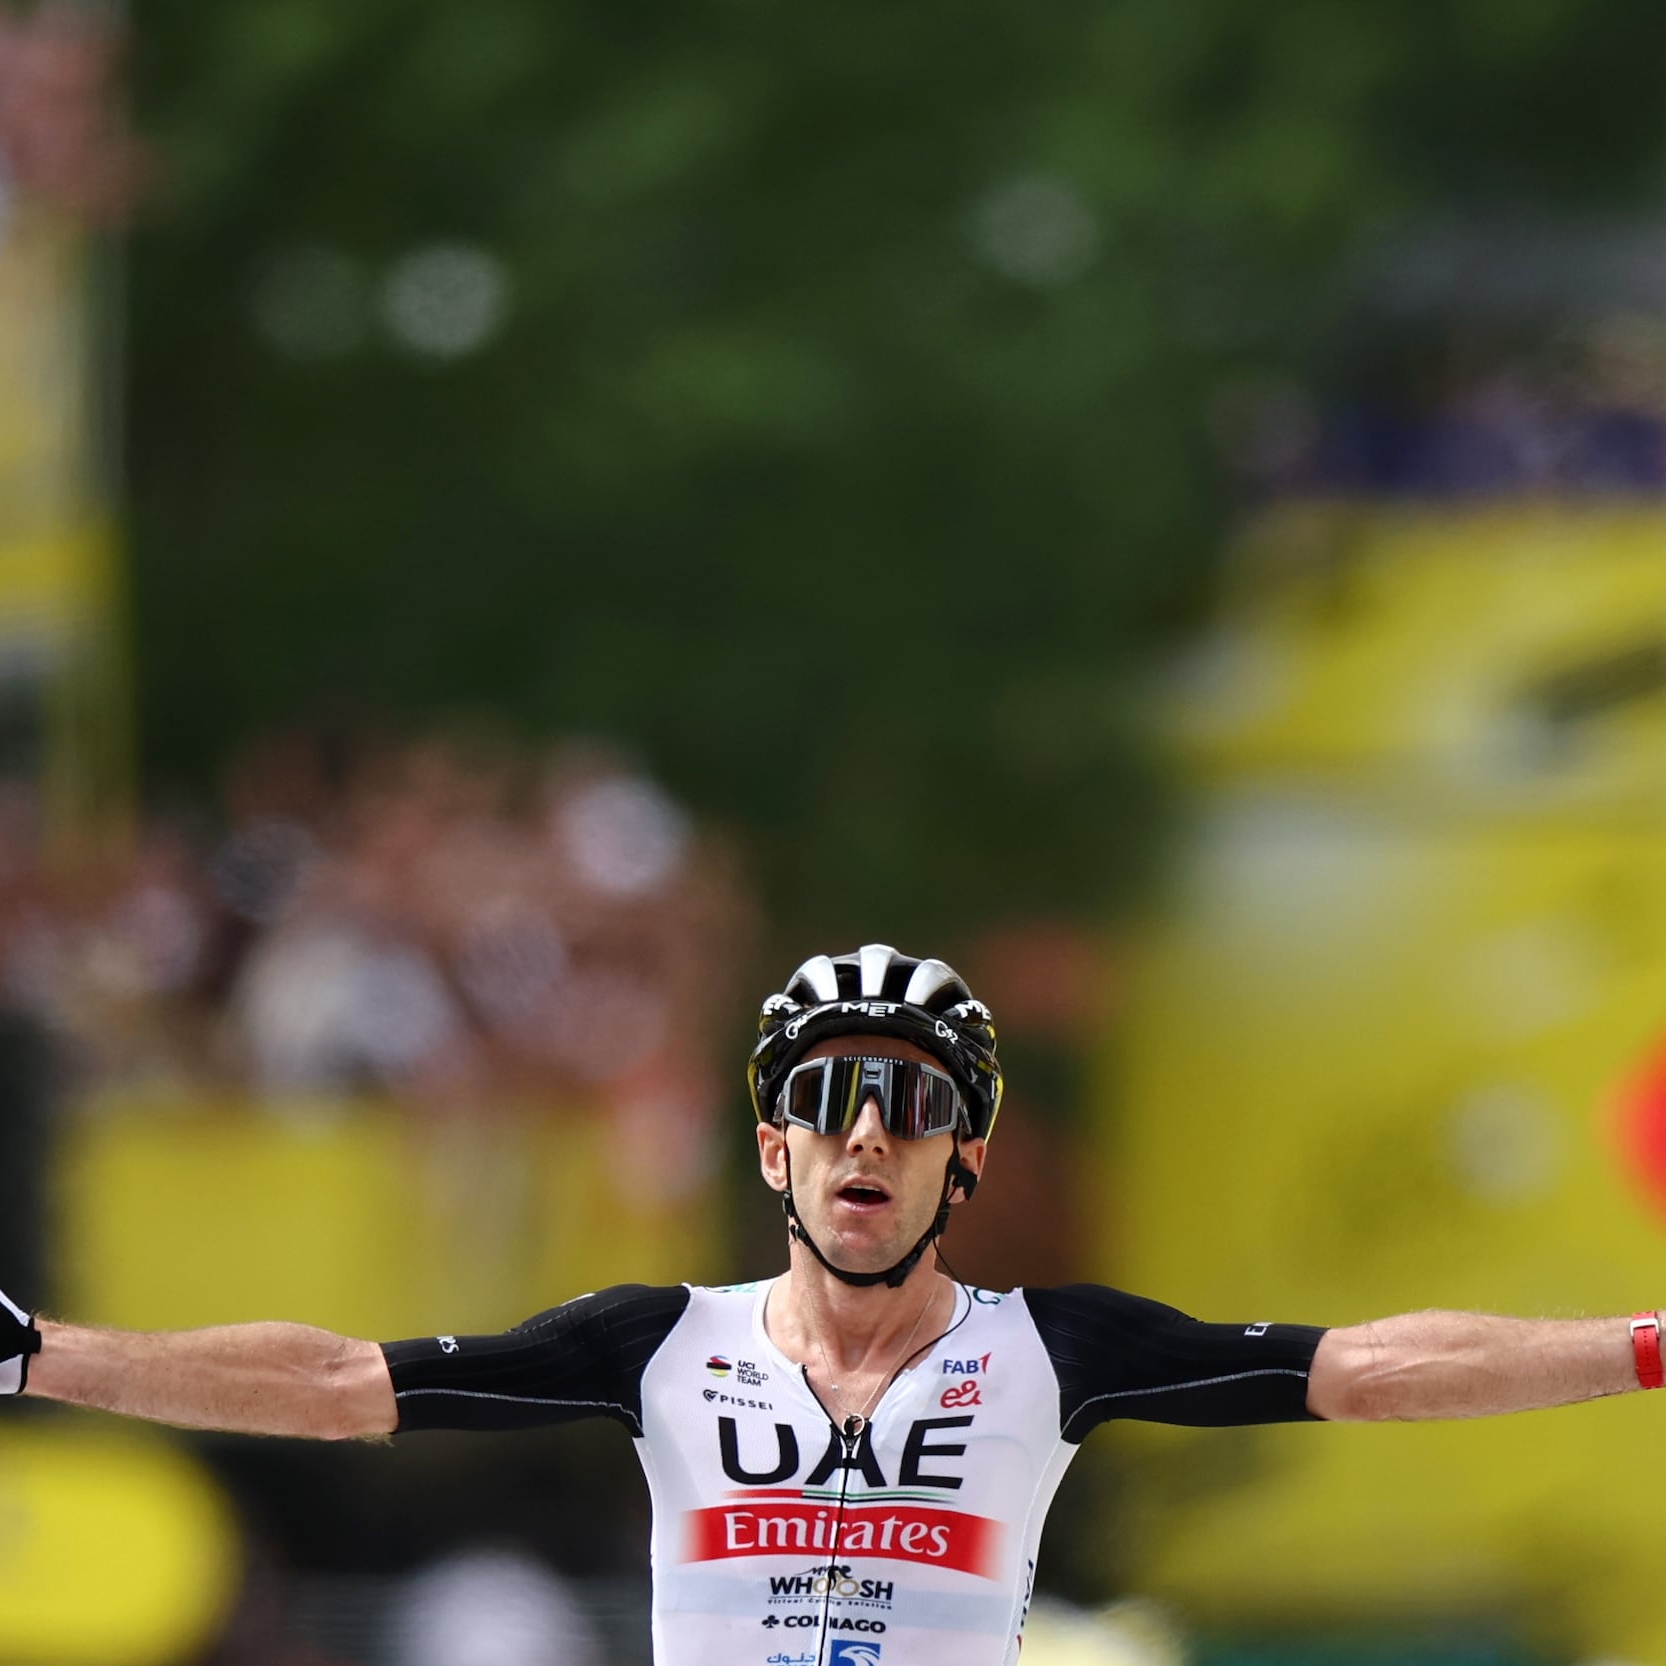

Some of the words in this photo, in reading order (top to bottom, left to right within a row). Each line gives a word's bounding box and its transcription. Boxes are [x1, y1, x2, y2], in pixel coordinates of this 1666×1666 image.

[841, 1002, 902, 1017] MET
[738, 1360, 756, 1370] UCI
[737, 1367, 769, 1381] WORLD
[737, 1375, 762, 1387] TEAM
[720, 1394, 773, 1411] PISSEI
[717, 1415, 975, 1490] UAE
[724, 1510, 950, 1557] Emirates
[769, 1577, 893, 1601] WHOOSH
